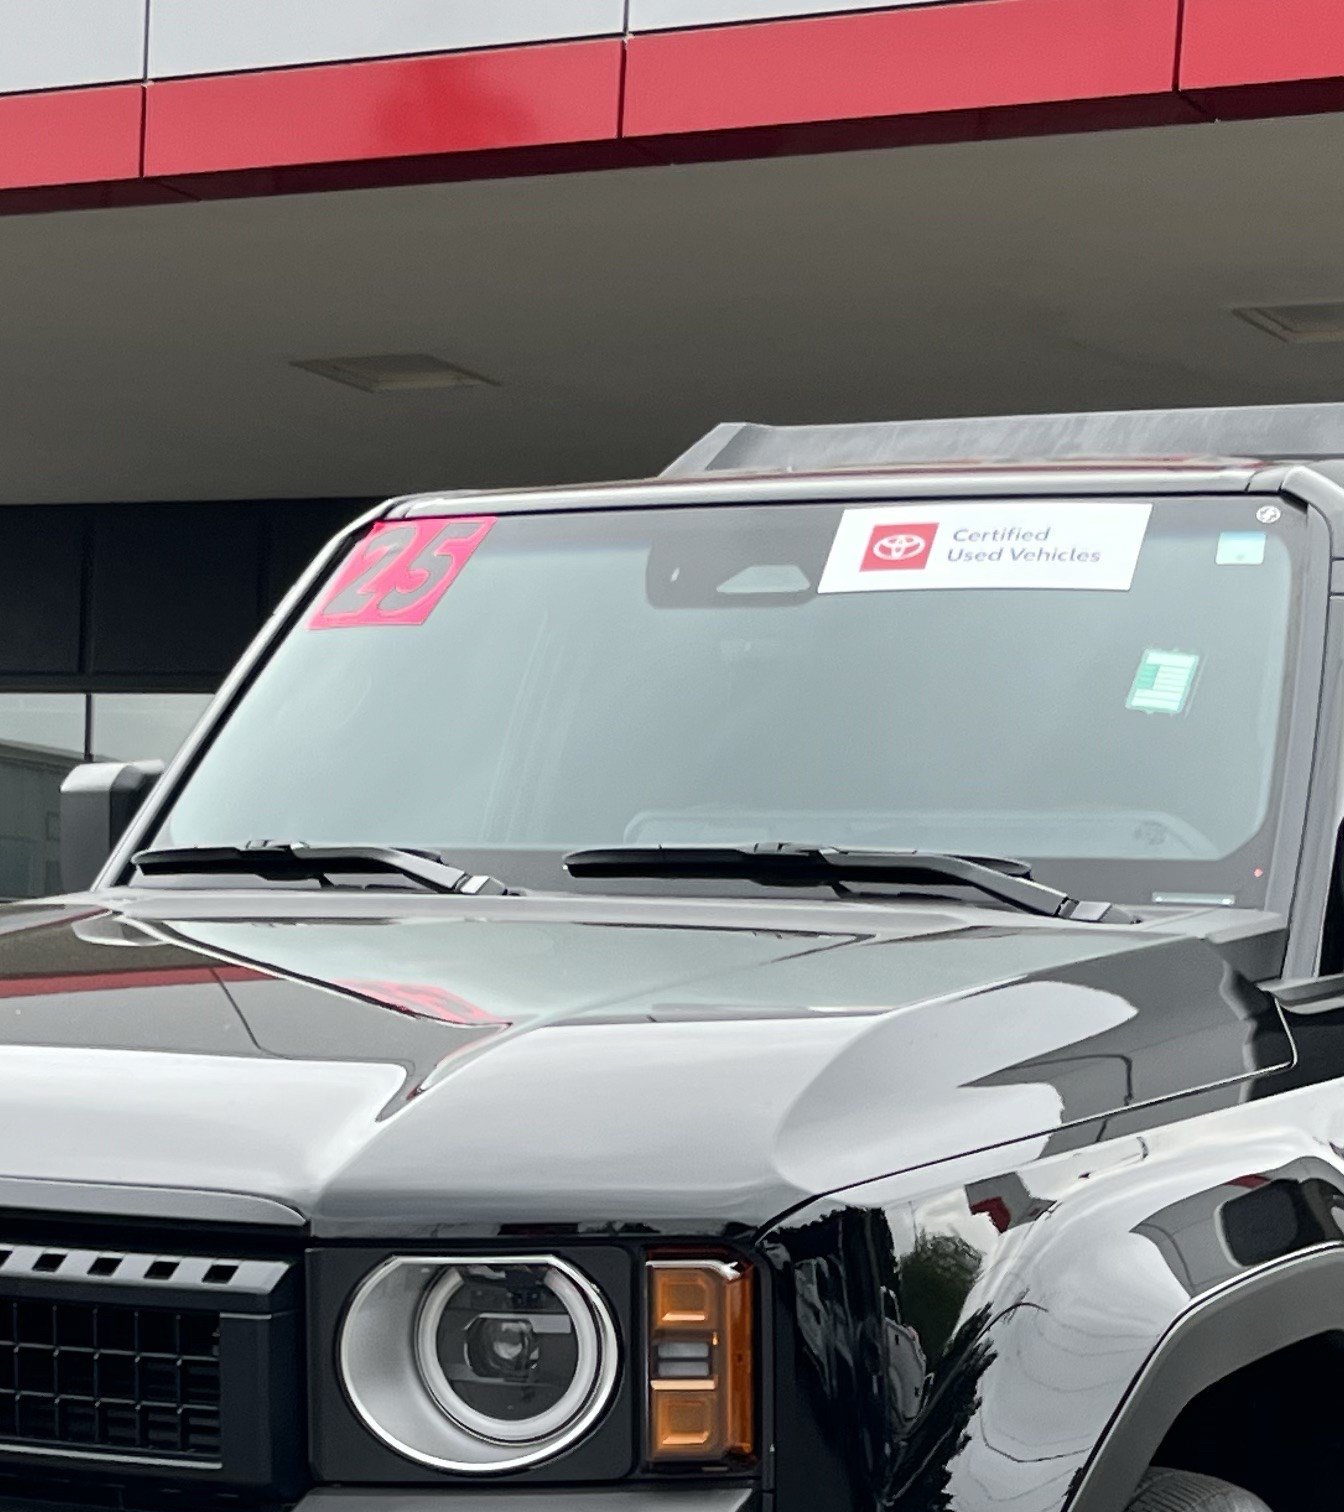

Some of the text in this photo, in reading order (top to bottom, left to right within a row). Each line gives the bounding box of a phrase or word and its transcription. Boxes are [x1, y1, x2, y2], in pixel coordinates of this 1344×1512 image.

[952, 526, 1051, 542] Certified
[947, 547, 1102, 562] Used Vehicles
[321, 521, 486, 613] 25
